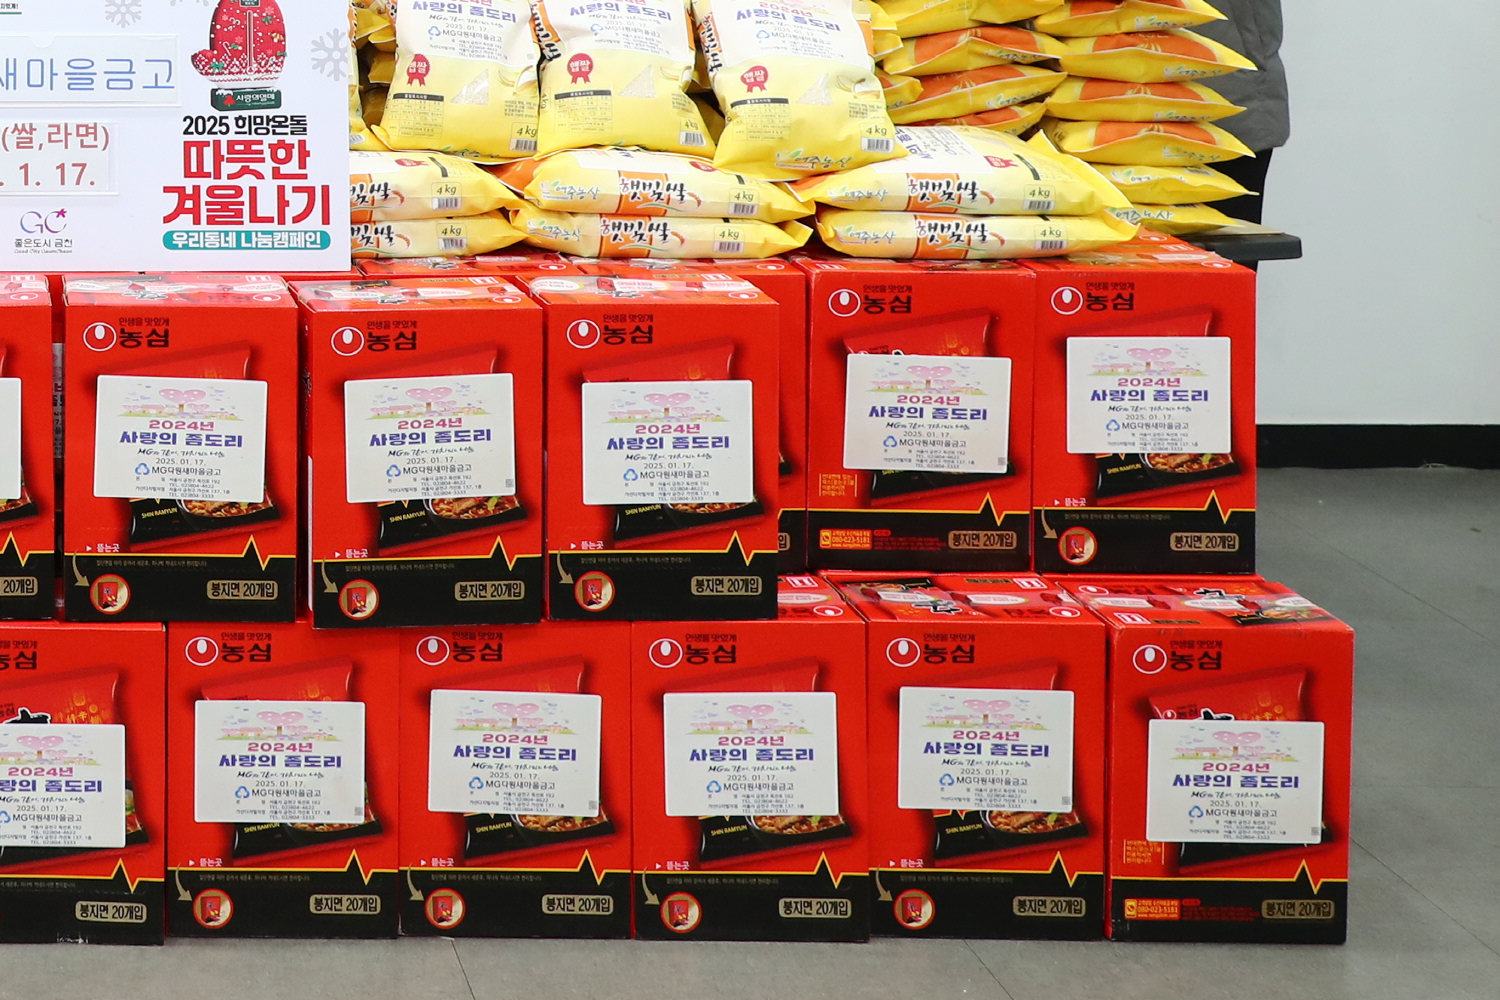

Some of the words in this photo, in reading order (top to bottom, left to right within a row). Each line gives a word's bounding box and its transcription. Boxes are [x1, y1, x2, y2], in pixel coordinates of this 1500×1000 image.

[412, 0, 464, 15] 사랑의
[469, 5, 517, 23] 좀도리
[569, 1, 622, 17] 사랑의
[627, 5, 673, 21] 좀도리
[759, 1, 814, 18] 2024년
[736, 10, 787, 22] 사랑의
[792, 16, 842, 32] 좀도리
[182, 115, 231, 136] 2025
[234, 114, 308, 136] 희망온돌
[183, 139, 311, 181] 따뜻한
[18, 162, 41, 187] 1.
[55, 162, 96, 187] 17.
[162, 184, 331, 226] 겨울나기
[14, 238, 51, 248] 좋은도시
[54, 238, 73, 248] 금천
[172, 231, 236, 248] 우리동네
[240, 231, 322, 248] 나눔캠페인
[862, 294, 911, 314] 농심
[366, 331, 418, 351] 농심
[1118, 377, 1181, 388] 2024년
[897, 395, 961, 406] 2024년
[1091, 389, 1145, 403] 사랑의
[1153, 389, 1209, 402] 좀도리
[869, 406, 925, 420] 사랑의
[932, 407, 988, 421] 좀도리
[398, 417, 463, 430] 2024년
[370, 432, 427, 447] 사랑의
[435, 429, 492, 444] 좀도리
[2, 579, 34, 594] 20개입
[458, 583, 487, 598] 봉지면
[490, 583, 522, 598] 20개입
[686, 644, 736, 664] 농심
[1170, 651, 1223, 671] 농심
[718, 736, 785, 747] 2024년
[689, 748, 748, 763] 사랑의
[756, 748, 814, 761] 좀도리
[8, 767, 74, 778] 2024년
[1203, 762, 1271, 774] 2024년
[45, 780, 103, 793] 좀도리
[1173, 774, 1232, 790] 사랑의
[1241, 775, 1300, 789] 좀도리
[80, 904, 109, 919] 봉지면
[112, 904, 144, 919] 20개입
[1266, 901, 1295, 917] 봉지면
[1298, 901, 1331, 917] 20개입
